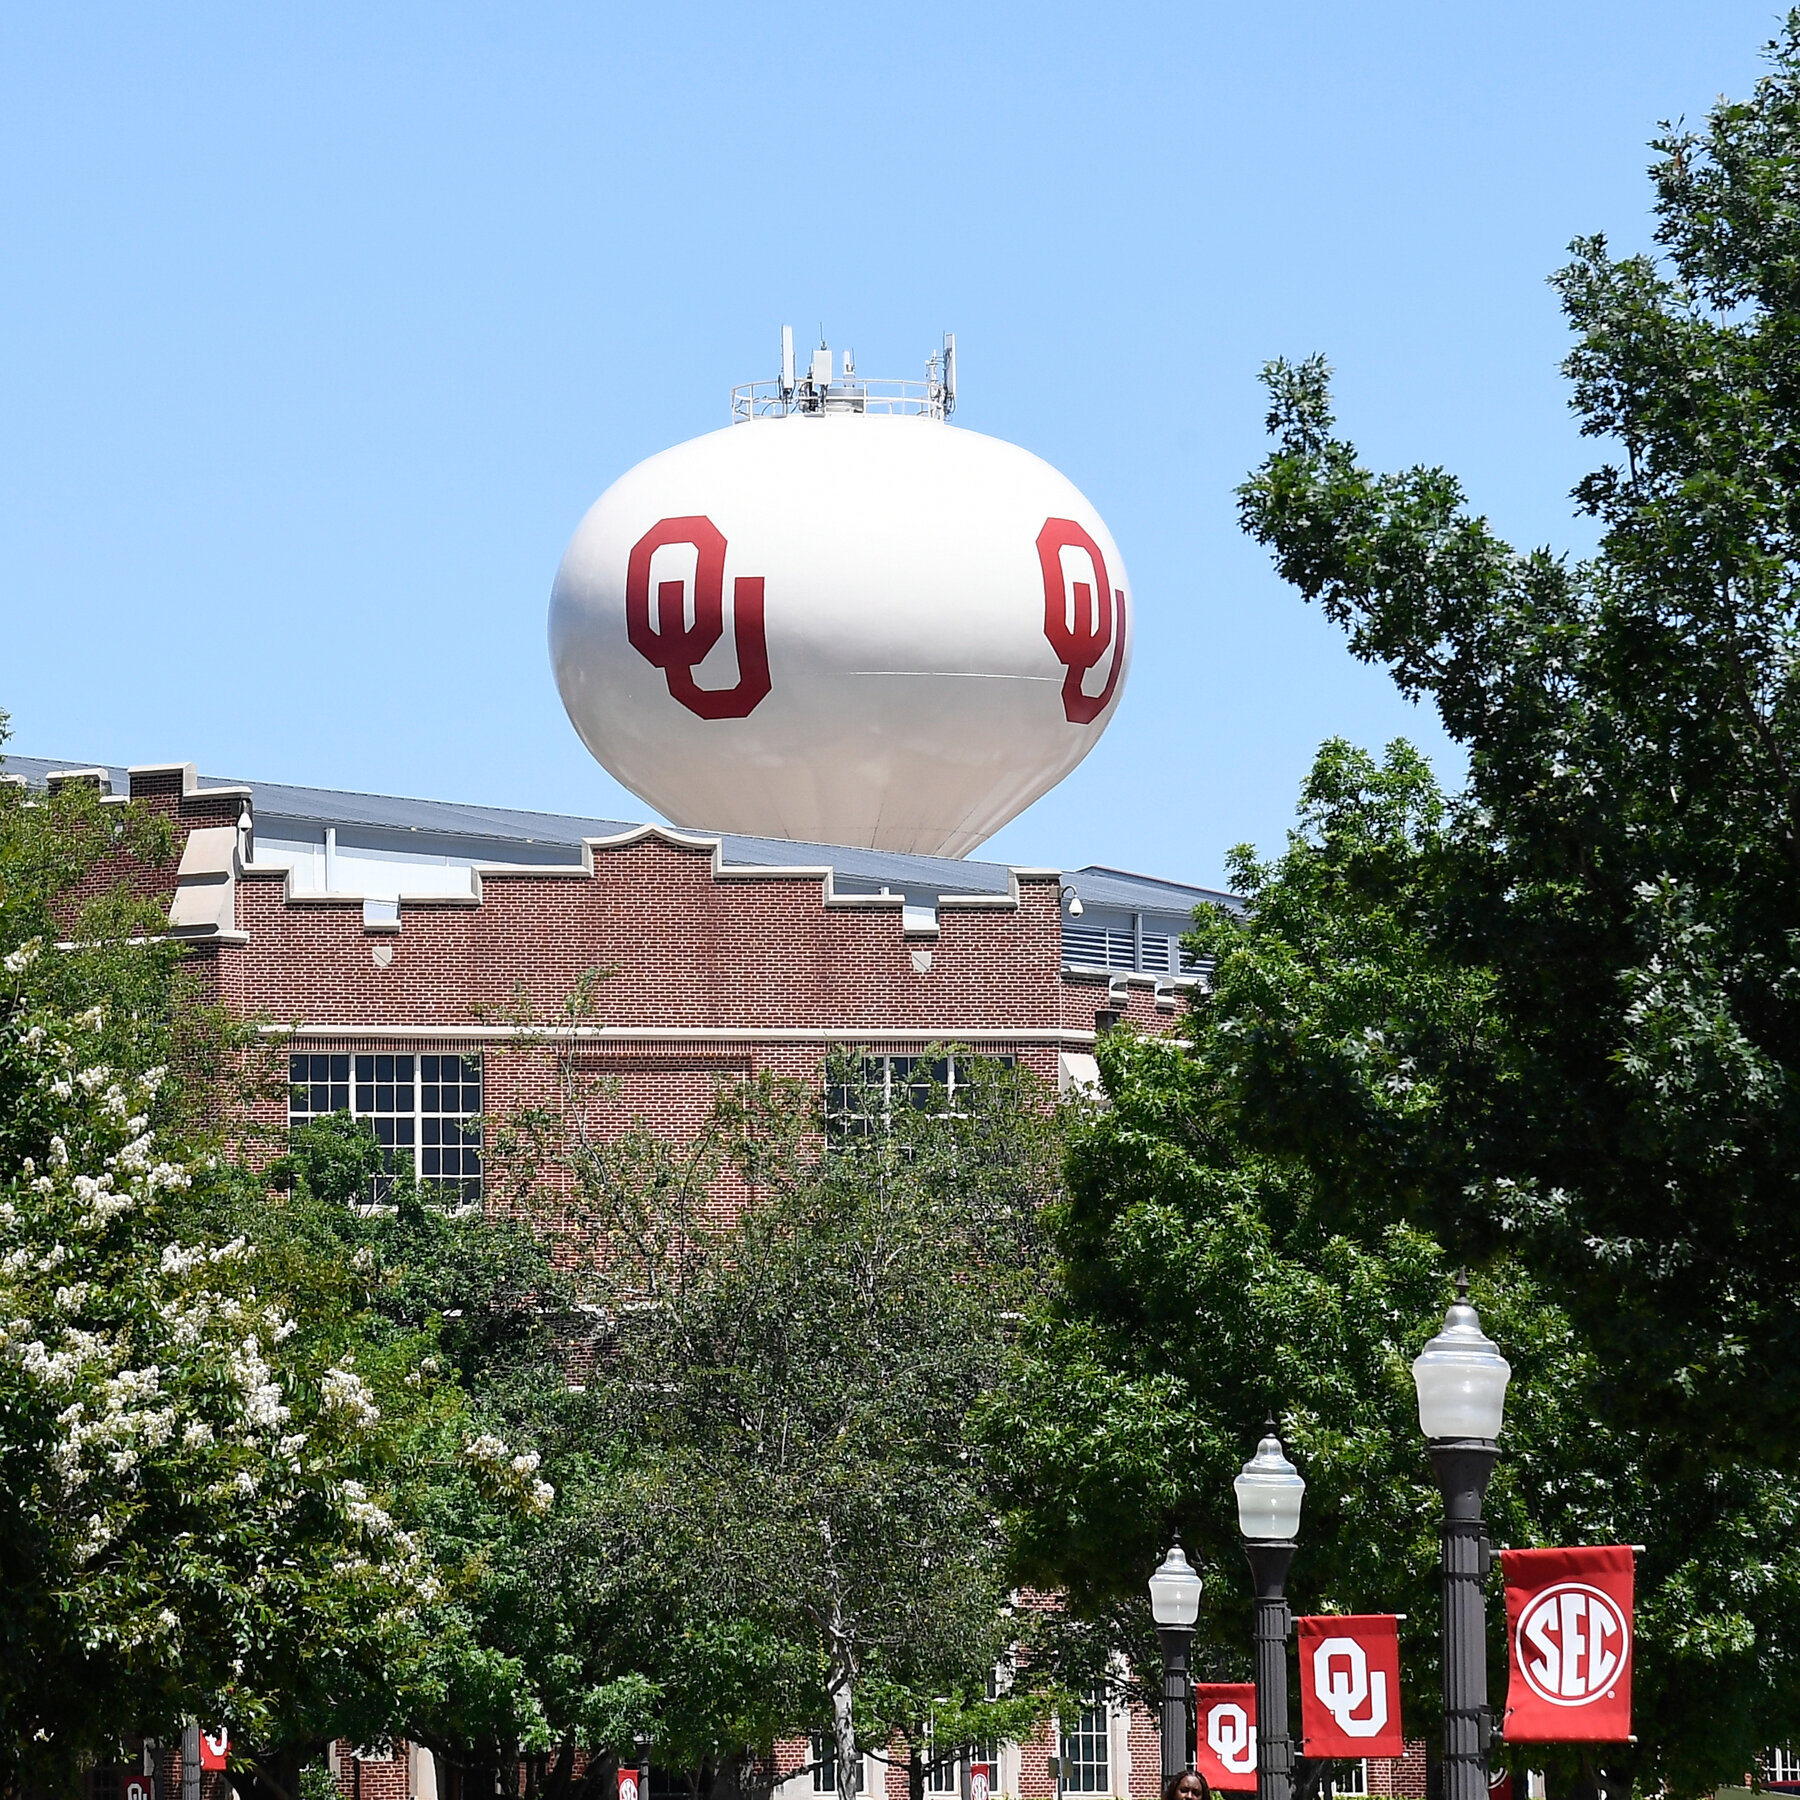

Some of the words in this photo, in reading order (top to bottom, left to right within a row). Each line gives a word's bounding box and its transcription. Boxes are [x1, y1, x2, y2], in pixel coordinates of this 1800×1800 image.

[625, 515, 773, 720] OU
[1035, 516, 1125, 724] OU
[1314, 1637, 1388, 1738] OU
[1525, 1593, 1617, 1696] SEC
[1207, 1703, 1257, 1774] OU
